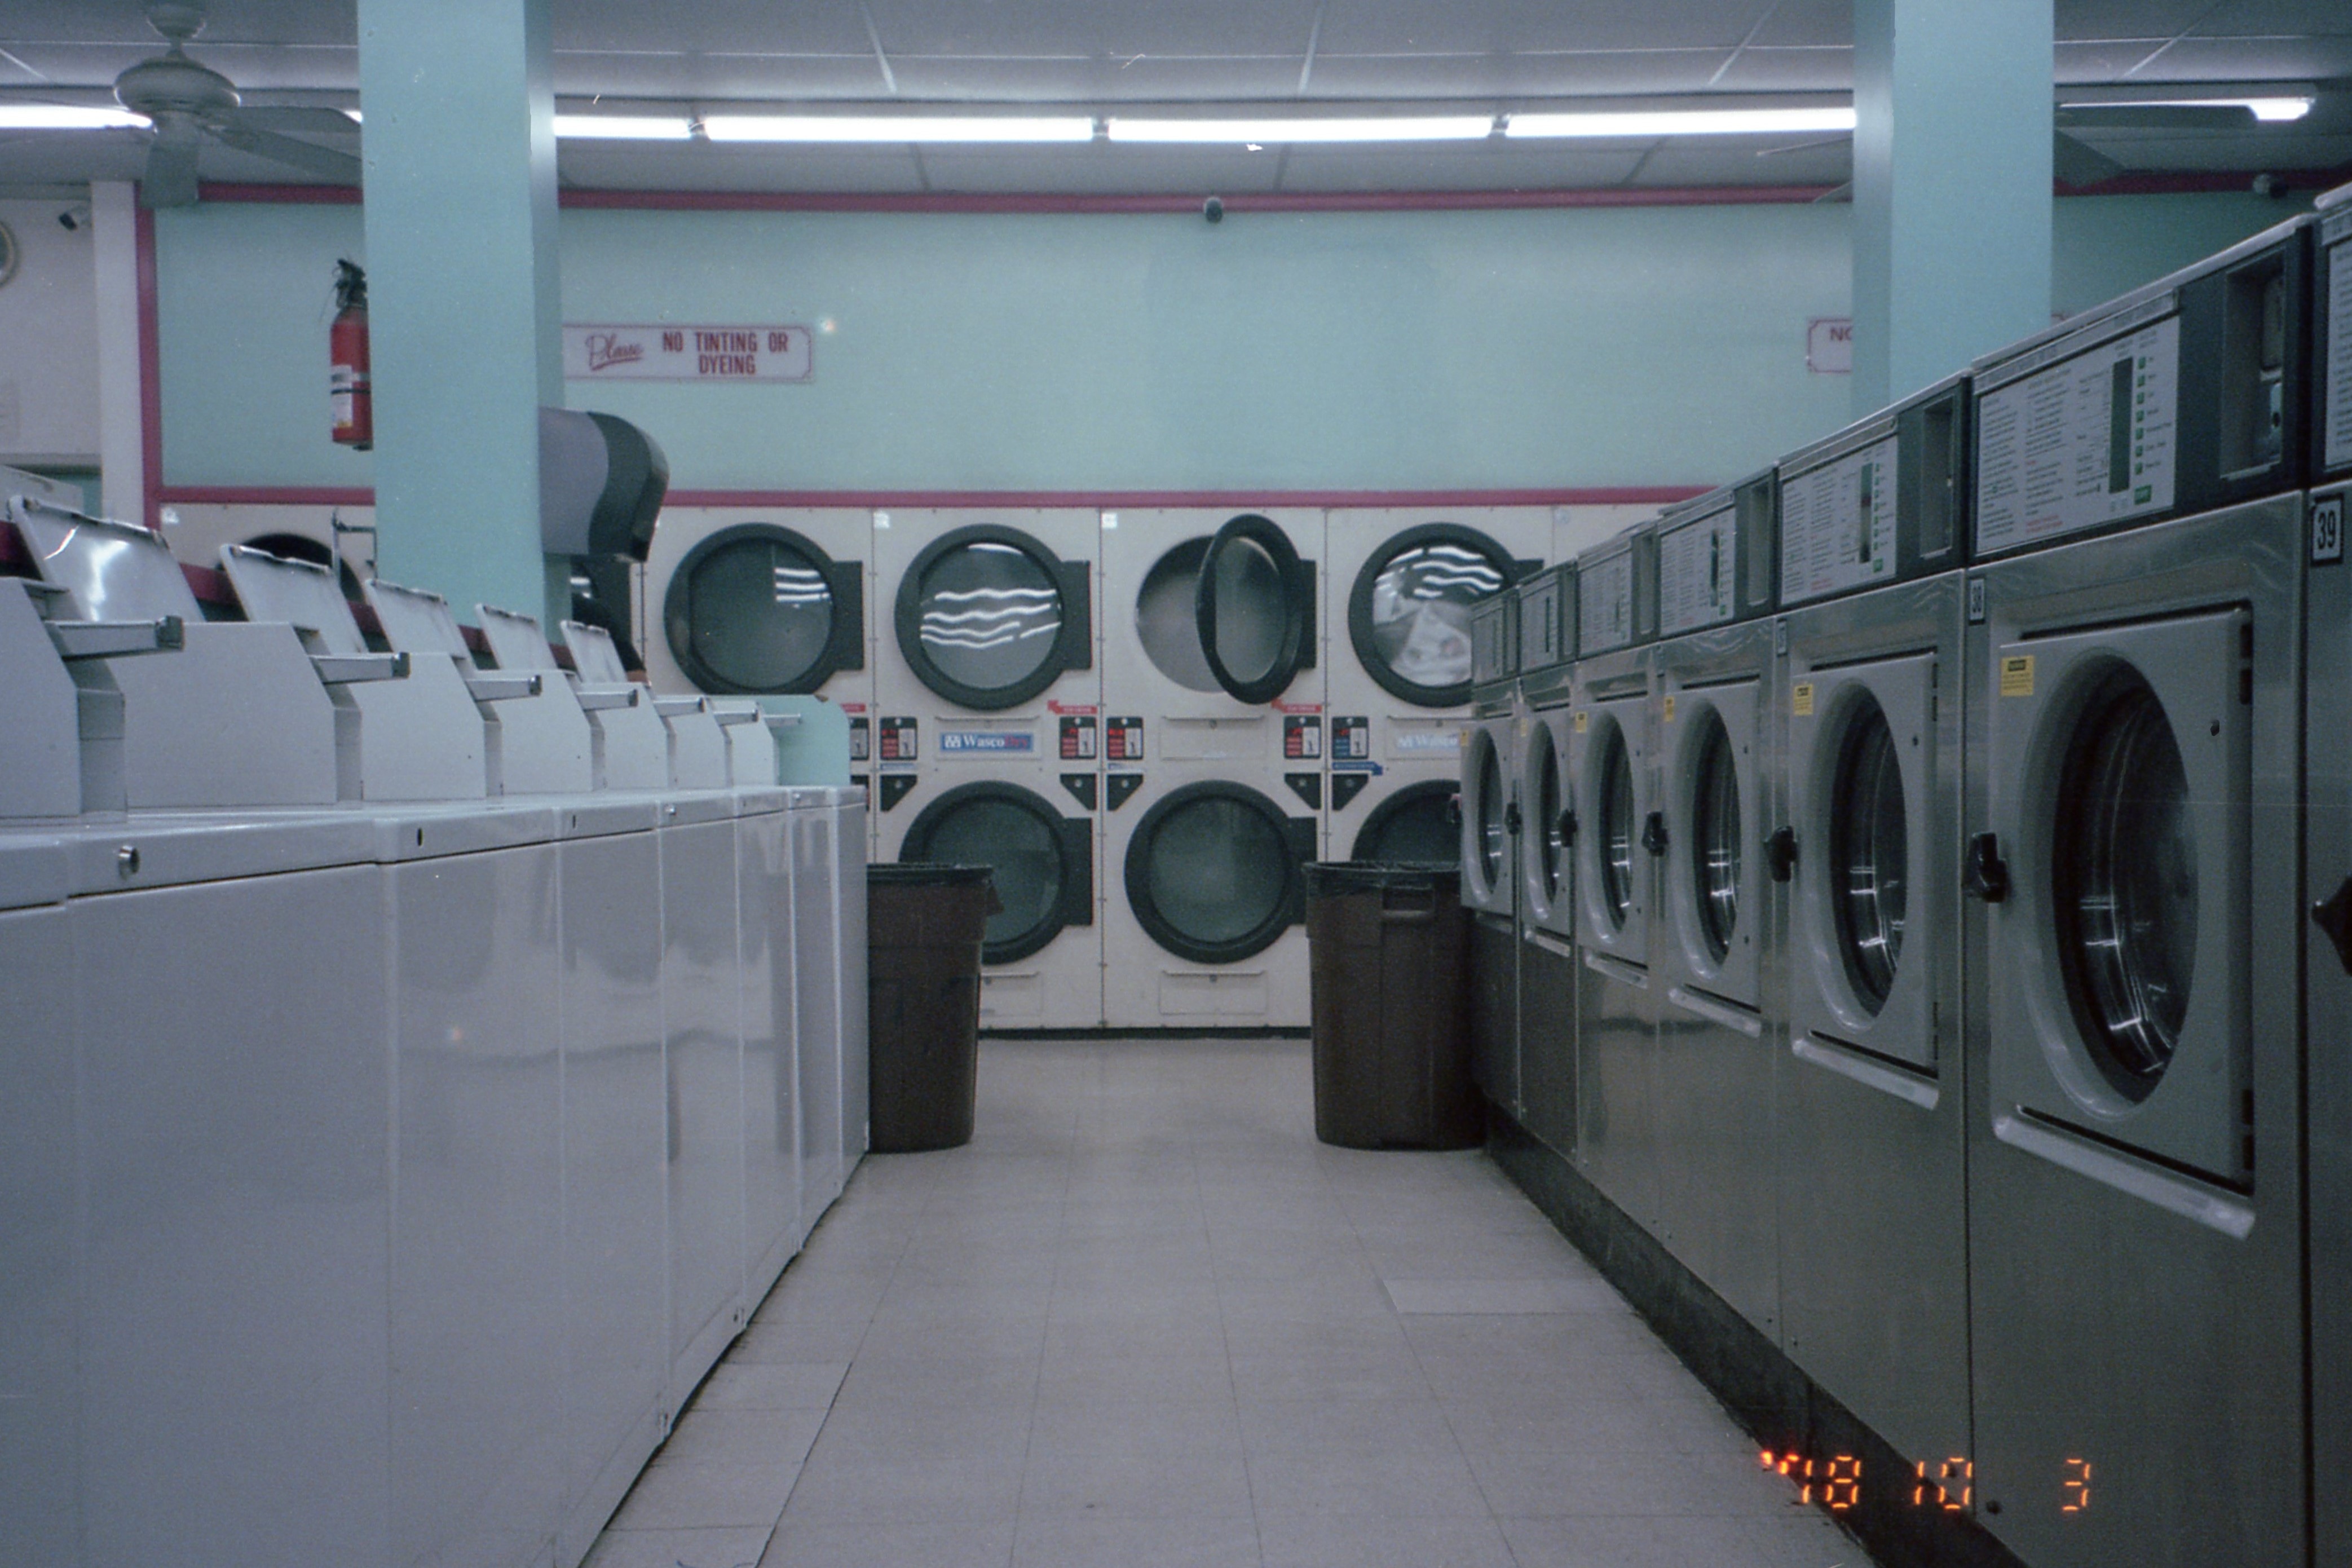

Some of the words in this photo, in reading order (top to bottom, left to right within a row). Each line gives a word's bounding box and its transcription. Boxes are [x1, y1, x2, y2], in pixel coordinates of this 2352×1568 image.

[663, 333, 683, 351] NO
[695, 333, 757, 352] TINTING
[769, 333, 788, 352] OR
[699, 355, 755, 374] DYEING
[2318, 510, 2336, 549] 39
